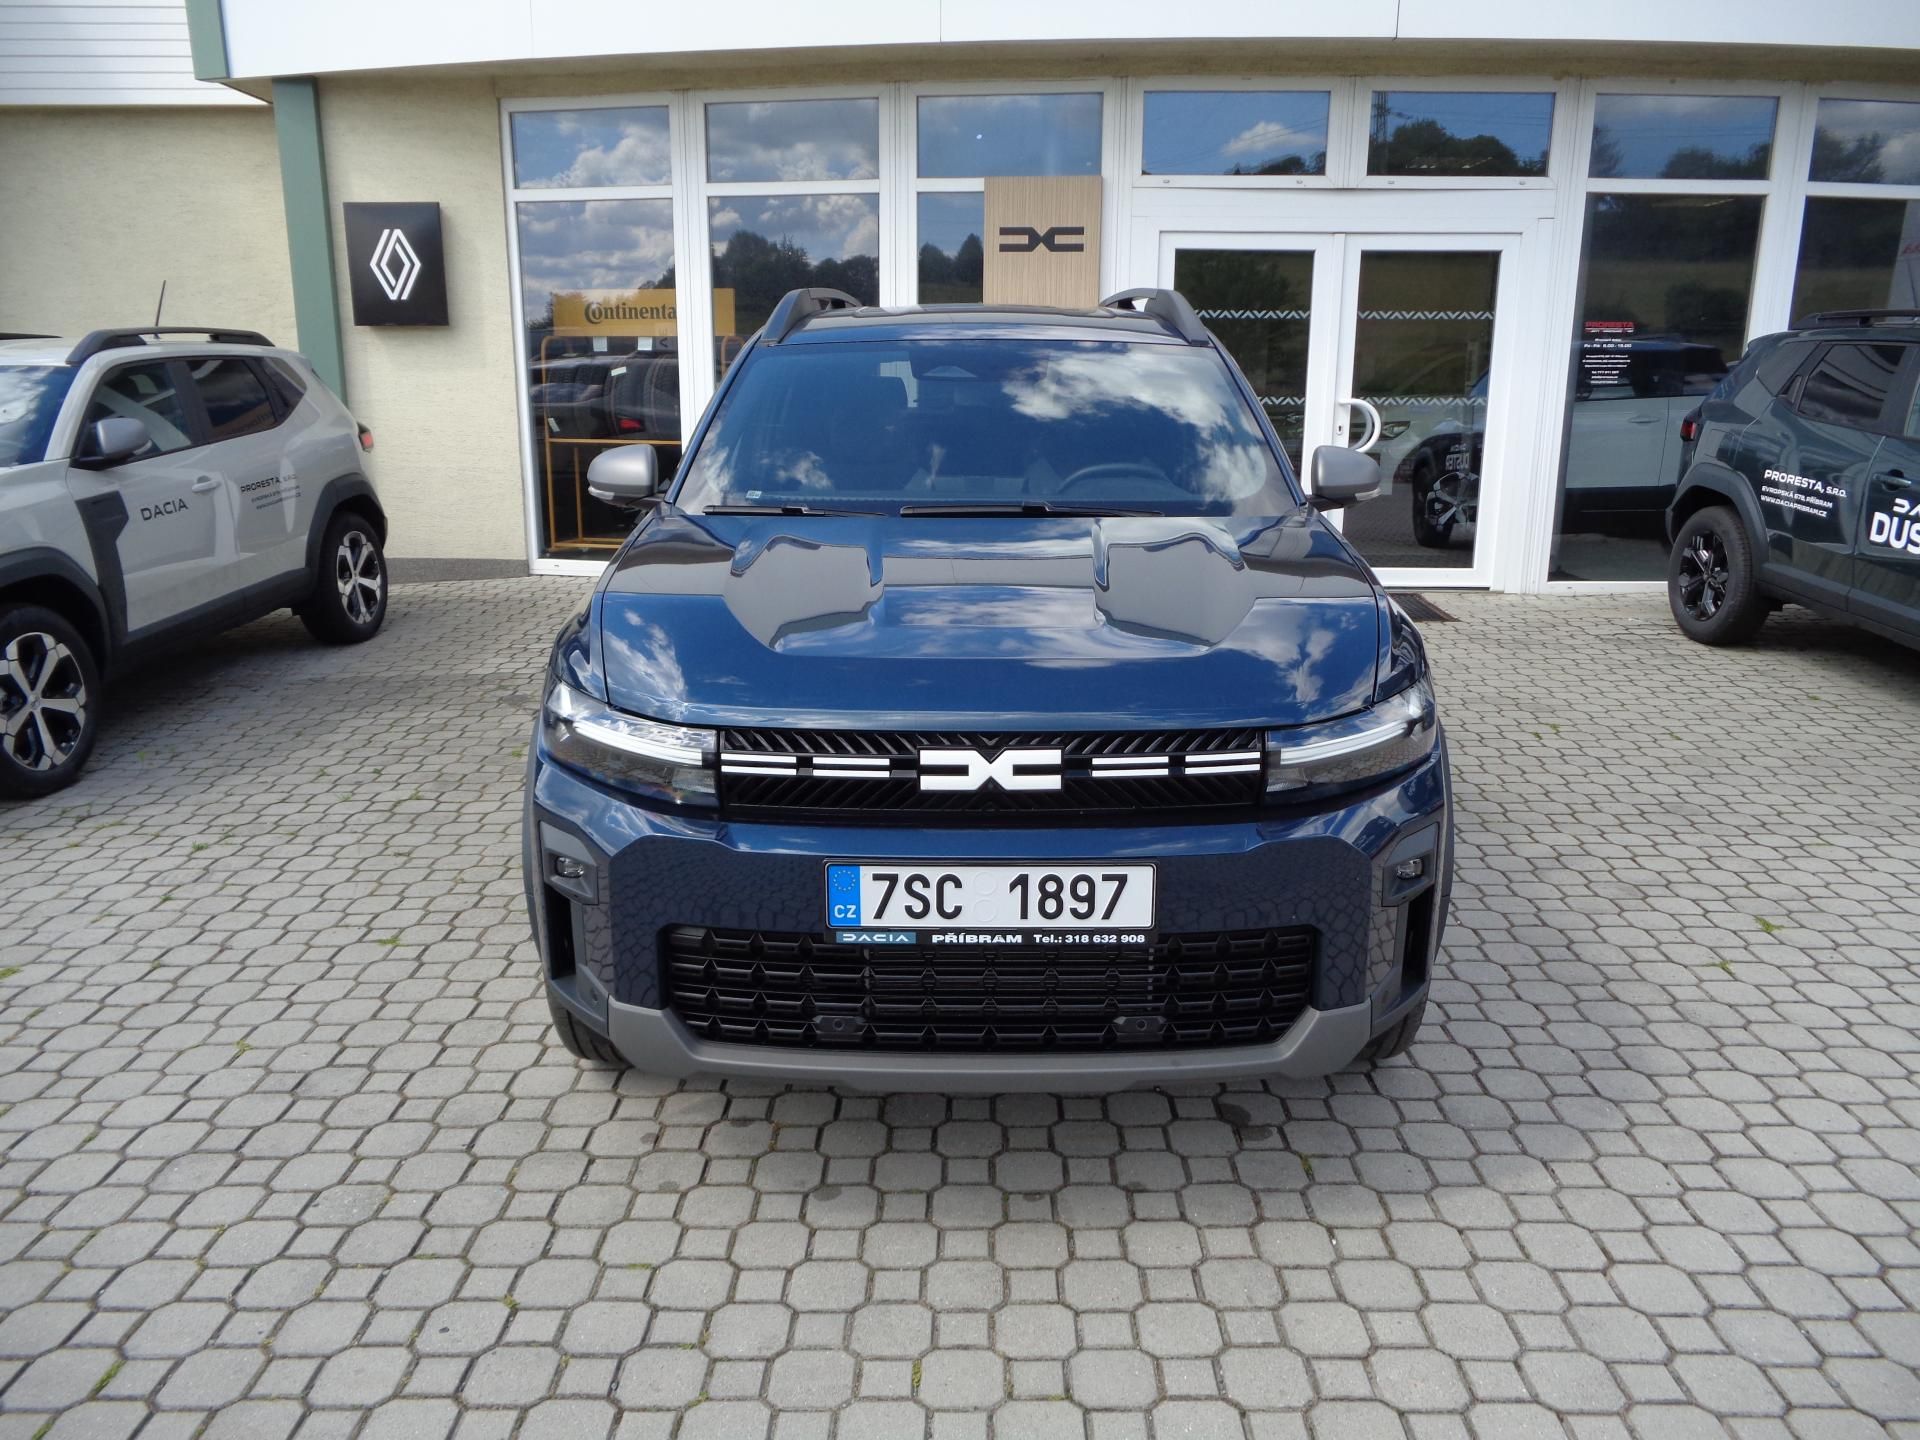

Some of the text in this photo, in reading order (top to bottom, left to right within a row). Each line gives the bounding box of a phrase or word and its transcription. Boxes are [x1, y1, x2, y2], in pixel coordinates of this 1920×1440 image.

[584, 301, 677, 325] Continenta
[1764, 469, 1824, 493] PRORESTA,
[140, 498, 189, 521] DACIA
[871, 873, 1129, 920] 7SC 1897
[834, 905, 857, 919] CZ
[931, 932, 1023, 944] PŘÍBRAM
[1033, 934, 1064, 944] Tel.:
[1065, 934, 1090, 944] 318
[1092, 934, 1118, 944] 632
[1120, 934, 1146, 944] 908
